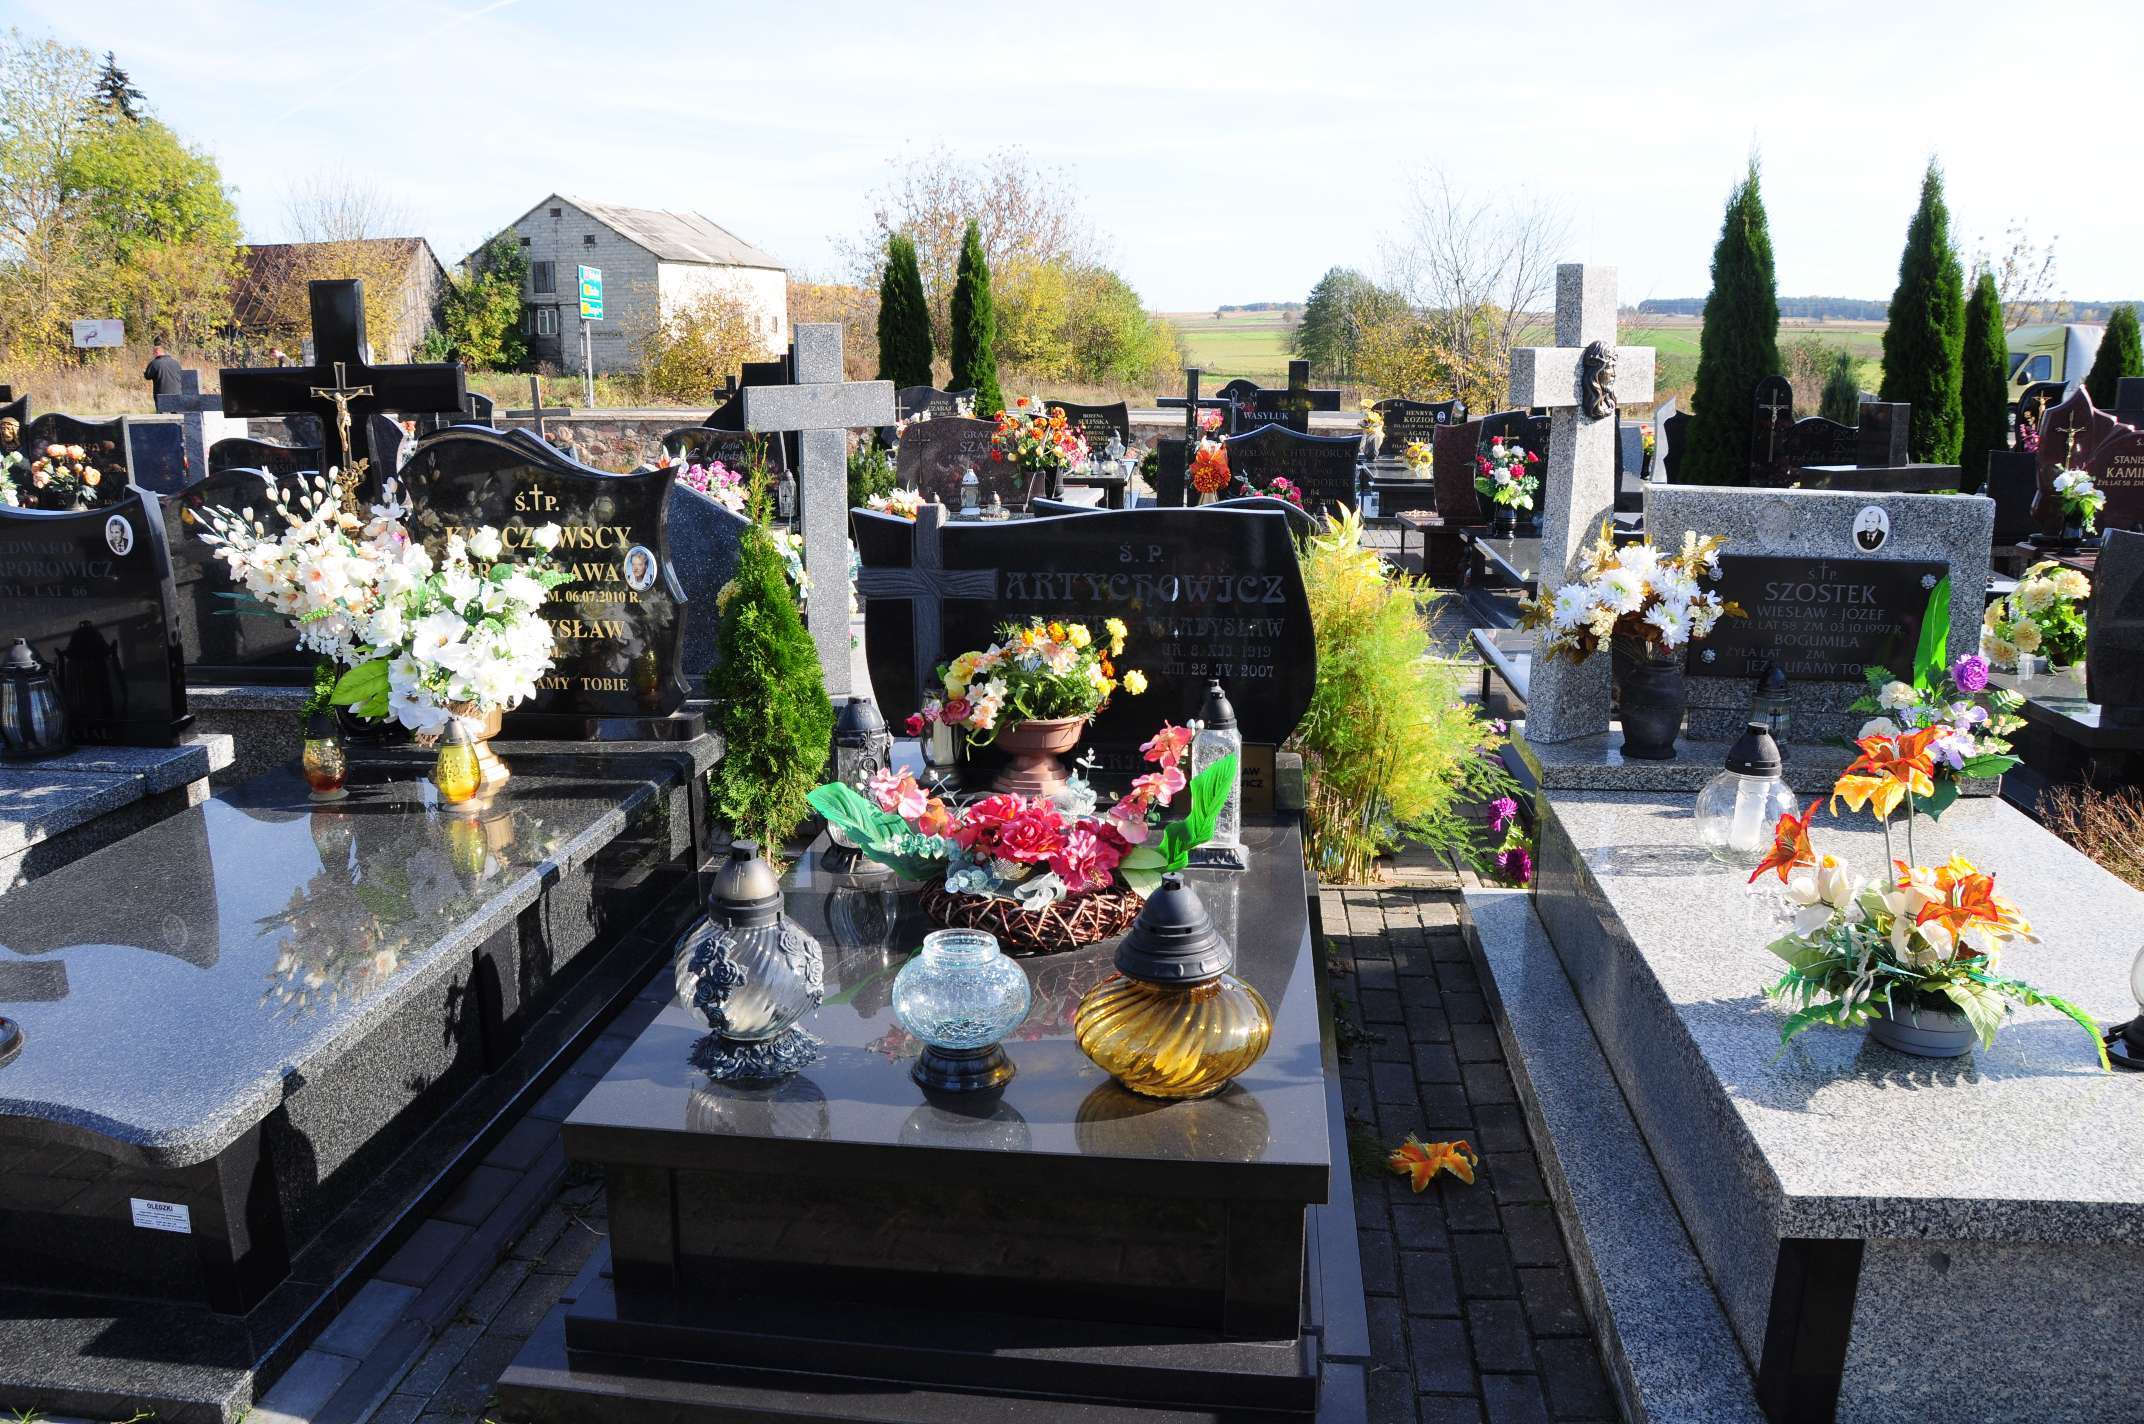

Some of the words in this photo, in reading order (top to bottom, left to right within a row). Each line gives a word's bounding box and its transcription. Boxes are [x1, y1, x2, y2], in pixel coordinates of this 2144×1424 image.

[545, 495, 561, 512] P.
[565, 590, 626, 603] 06.07.2010
[629, 590, 642, 603] R.
[1764, 581, 1878, 605] SZOSTEK
[1756, 604, 1829, 619] WIESŁAW
[1841, 604, 1889, 623] JÓZEF
[1774, 633, 1861, 648] BOGUMIŁA
[1240, 664, 1275, 678] 2007
[1744, 659, 1769, 674] JEZ
[580, 677, 630, 692] TOBIE
